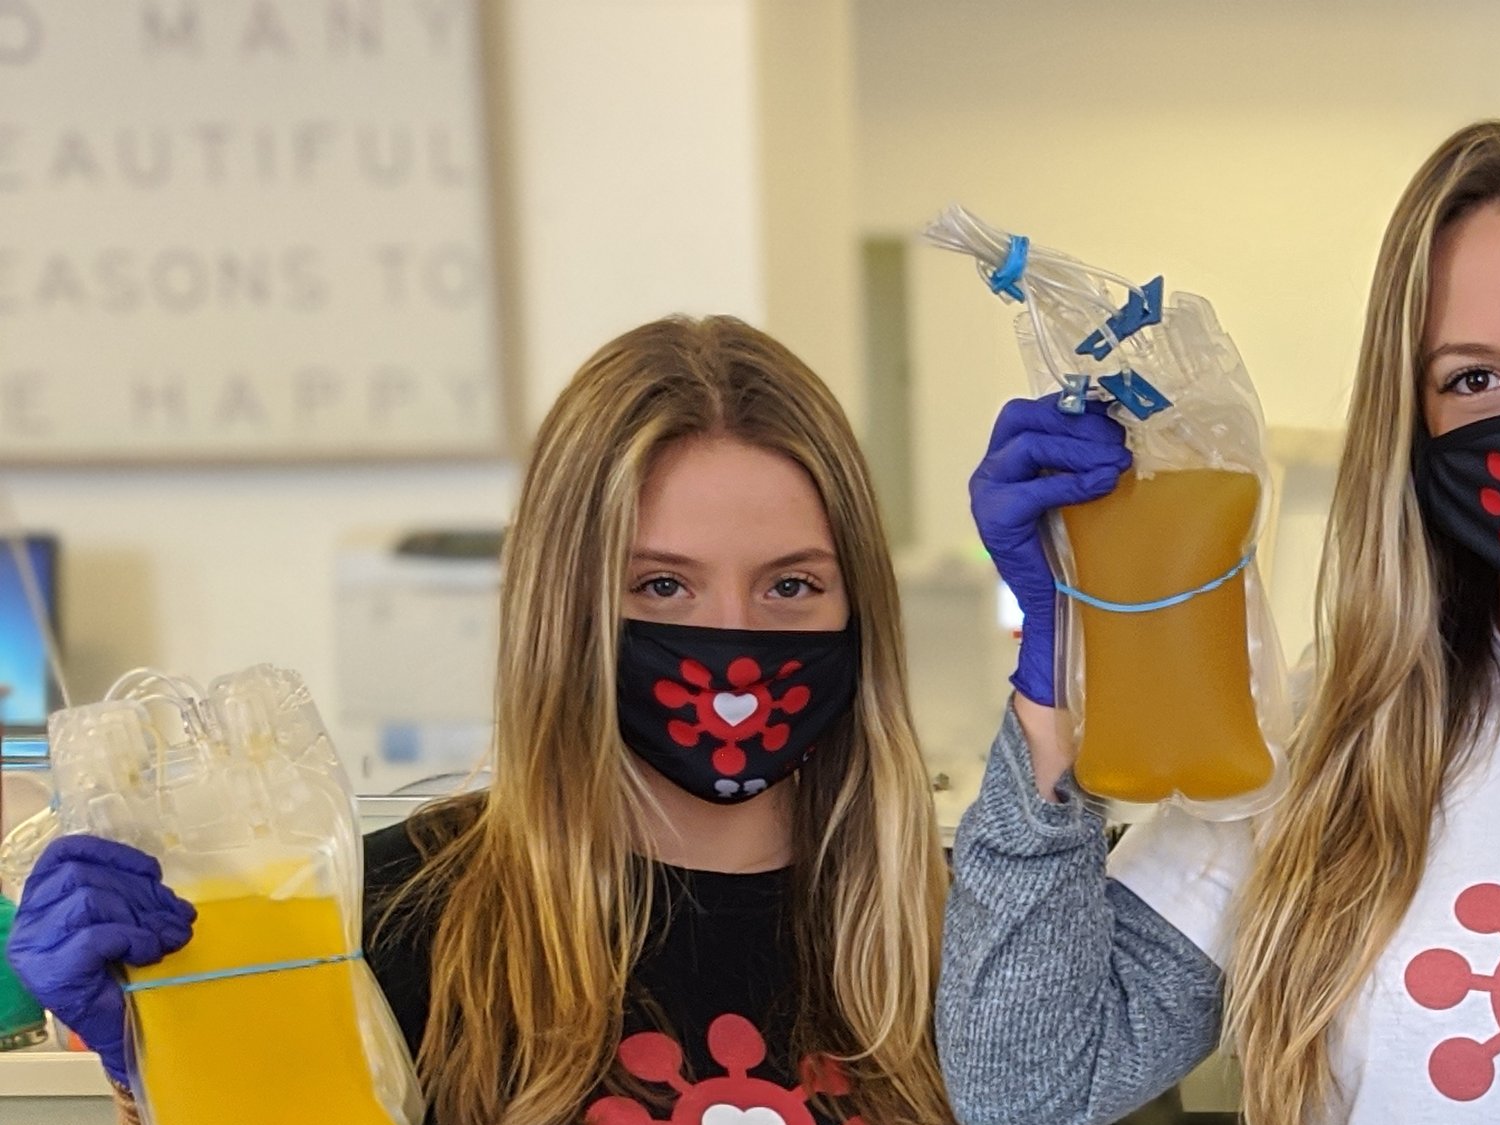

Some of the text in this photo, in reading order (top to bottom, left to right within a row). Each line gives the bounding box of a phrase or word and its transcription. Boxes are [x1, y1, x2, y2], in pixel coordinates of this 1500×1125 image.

[140, 0, 455, 60] MANY
[372, 243, 480, 312] TO
[131, 366, 483, 430] HAPPY
